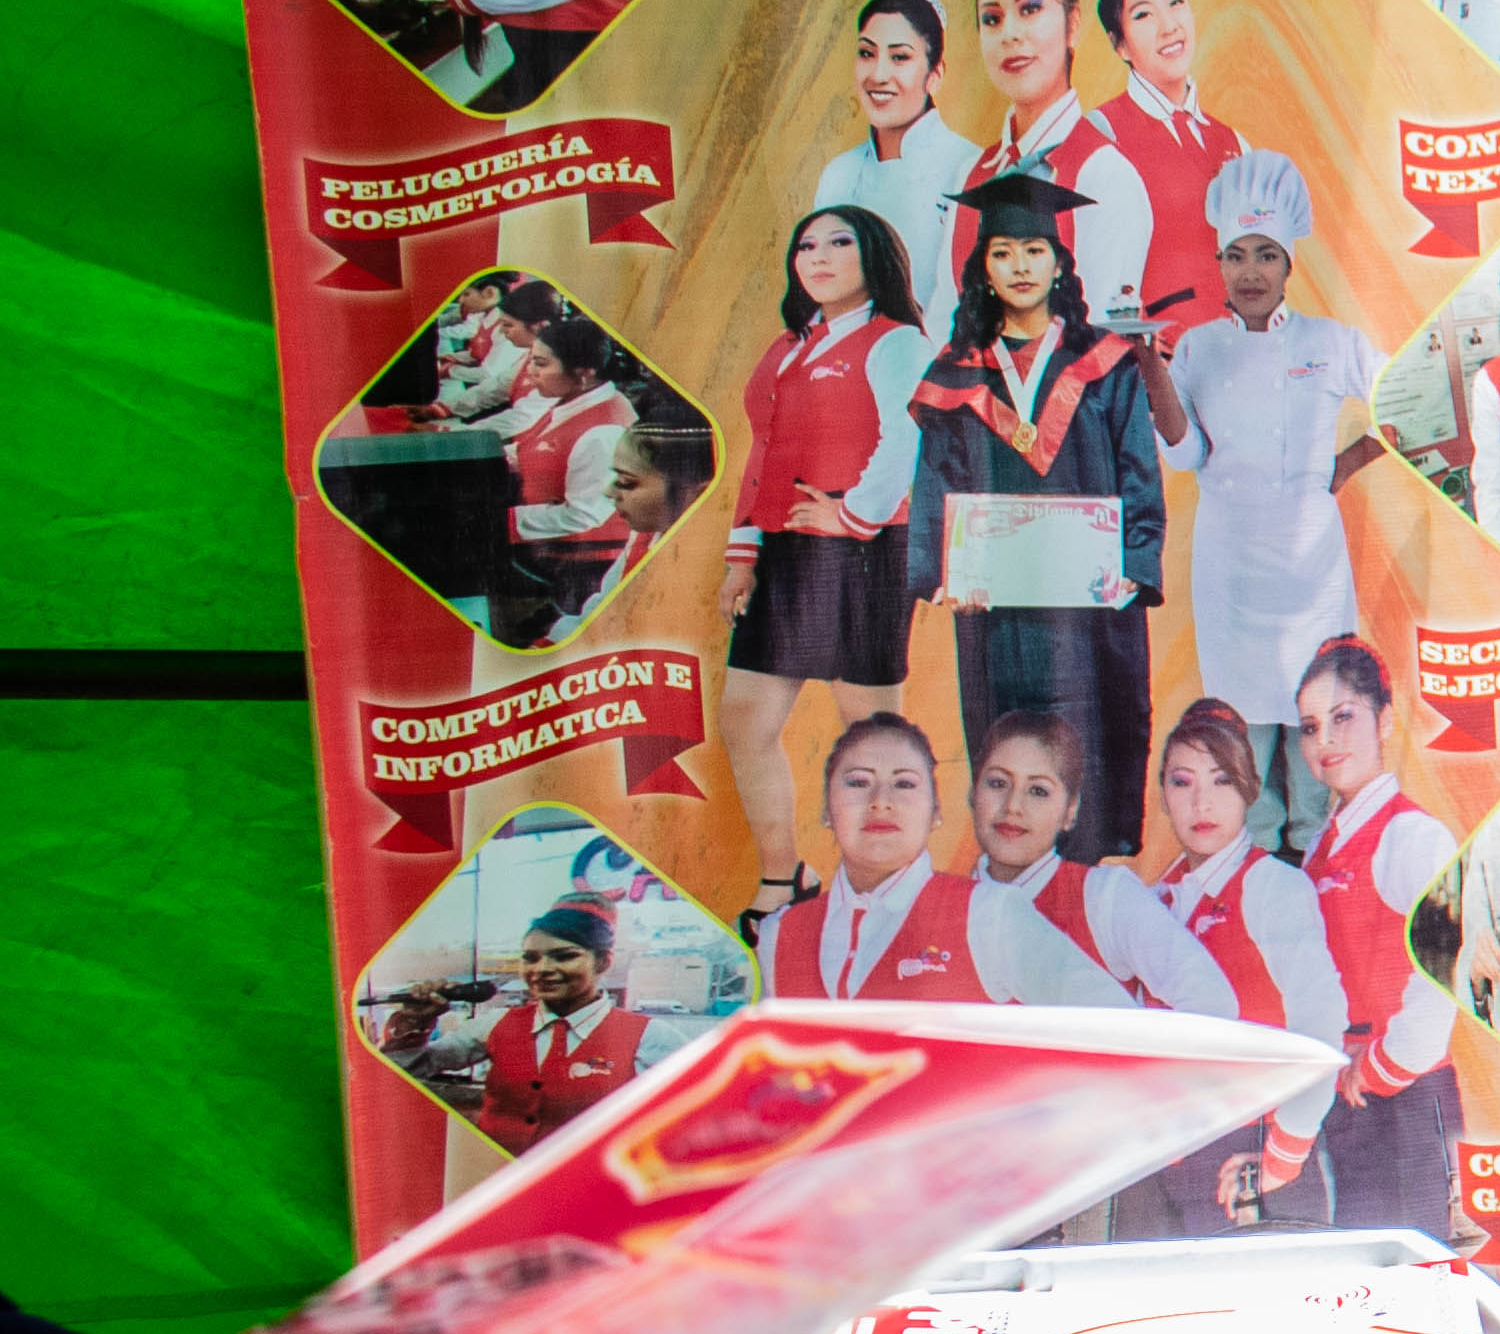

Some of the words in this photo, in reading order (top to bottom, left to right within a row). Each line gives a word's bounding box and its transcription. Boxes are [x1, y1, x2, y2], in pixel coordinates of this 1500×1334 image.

[320, 133, 592, 201] PELUQUERÍA
[323, 157, 661, 231] COSMETOLOGÍA
[371, 656, 655, 744] COMPUTACIÓN
[663, 662, 694, 690] E
[372, 699, 647, 783] INFORMATICA
